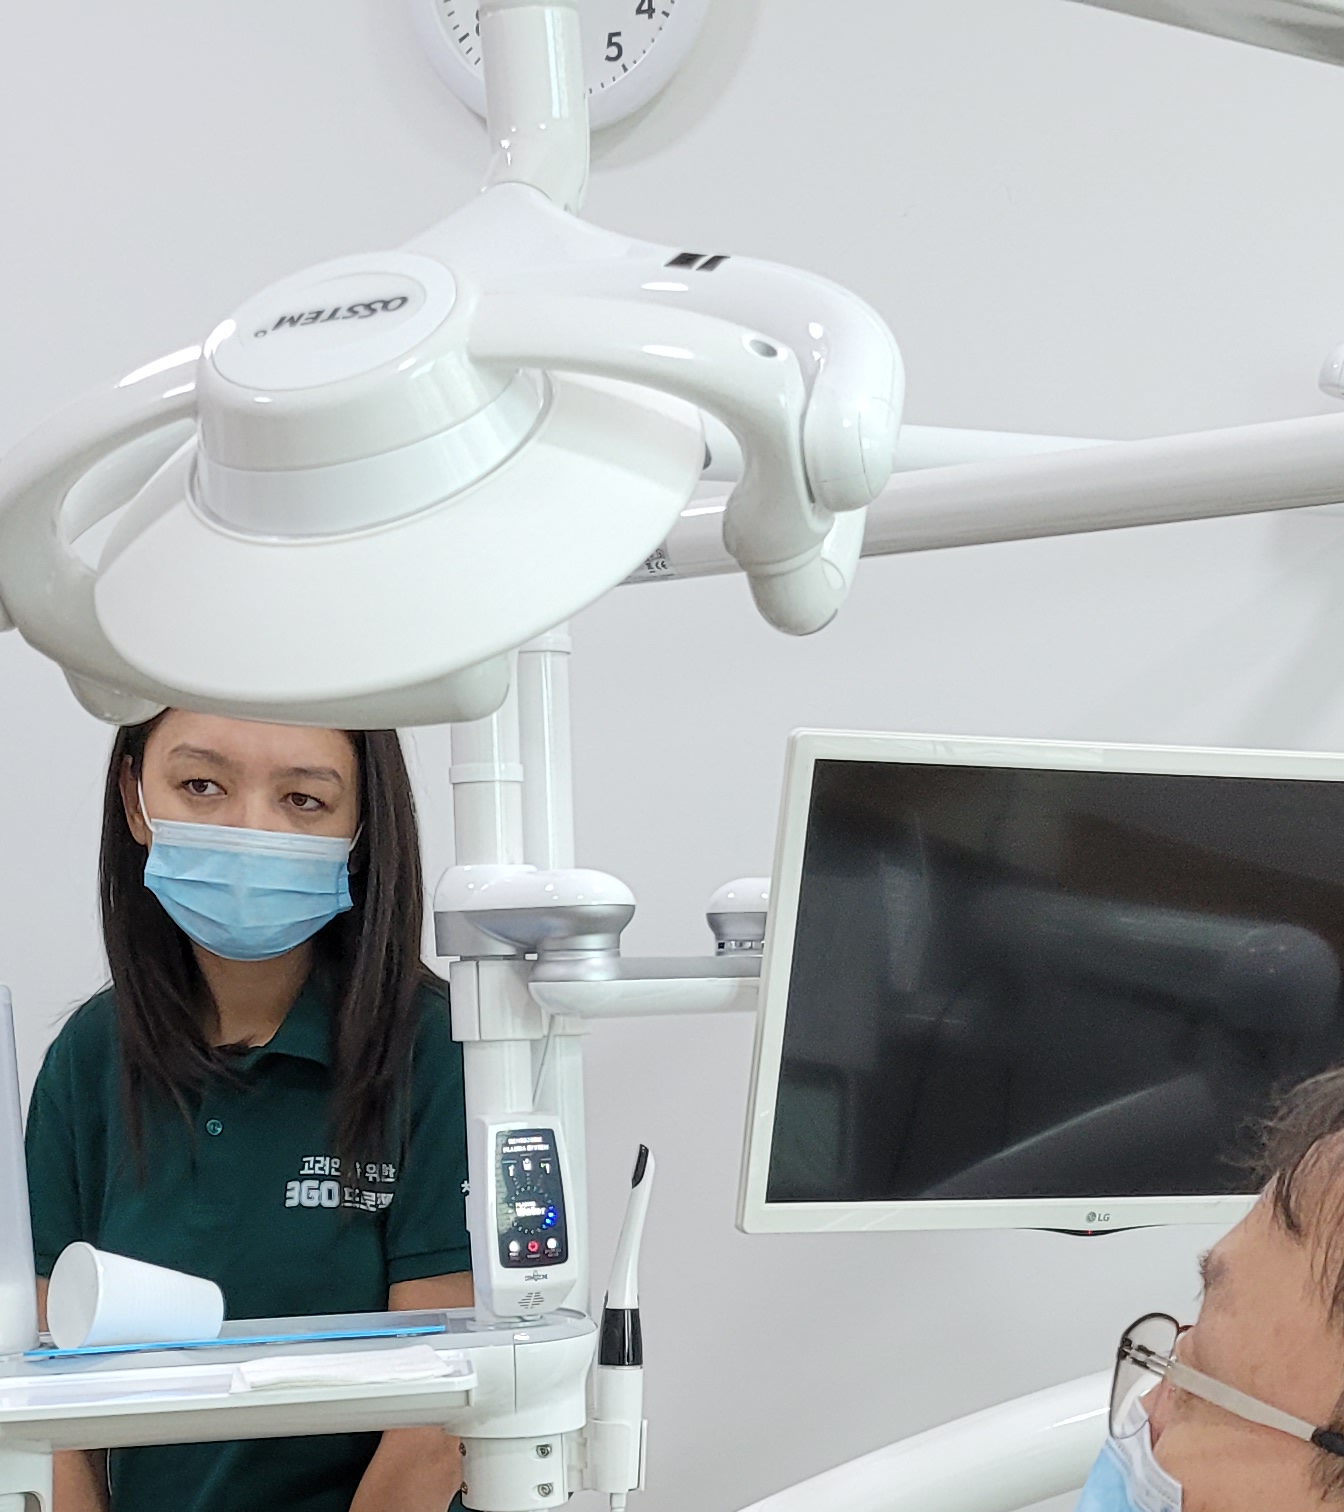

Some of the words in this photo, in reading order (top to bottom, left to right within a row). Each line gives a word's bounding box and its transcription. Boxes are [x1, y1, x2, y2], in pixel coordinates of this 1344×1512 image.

[605, 31, 623, 62] 5
[272, 296, 409, 331] OSSTEM
[1097, 1213, 1111, 1222] LG
